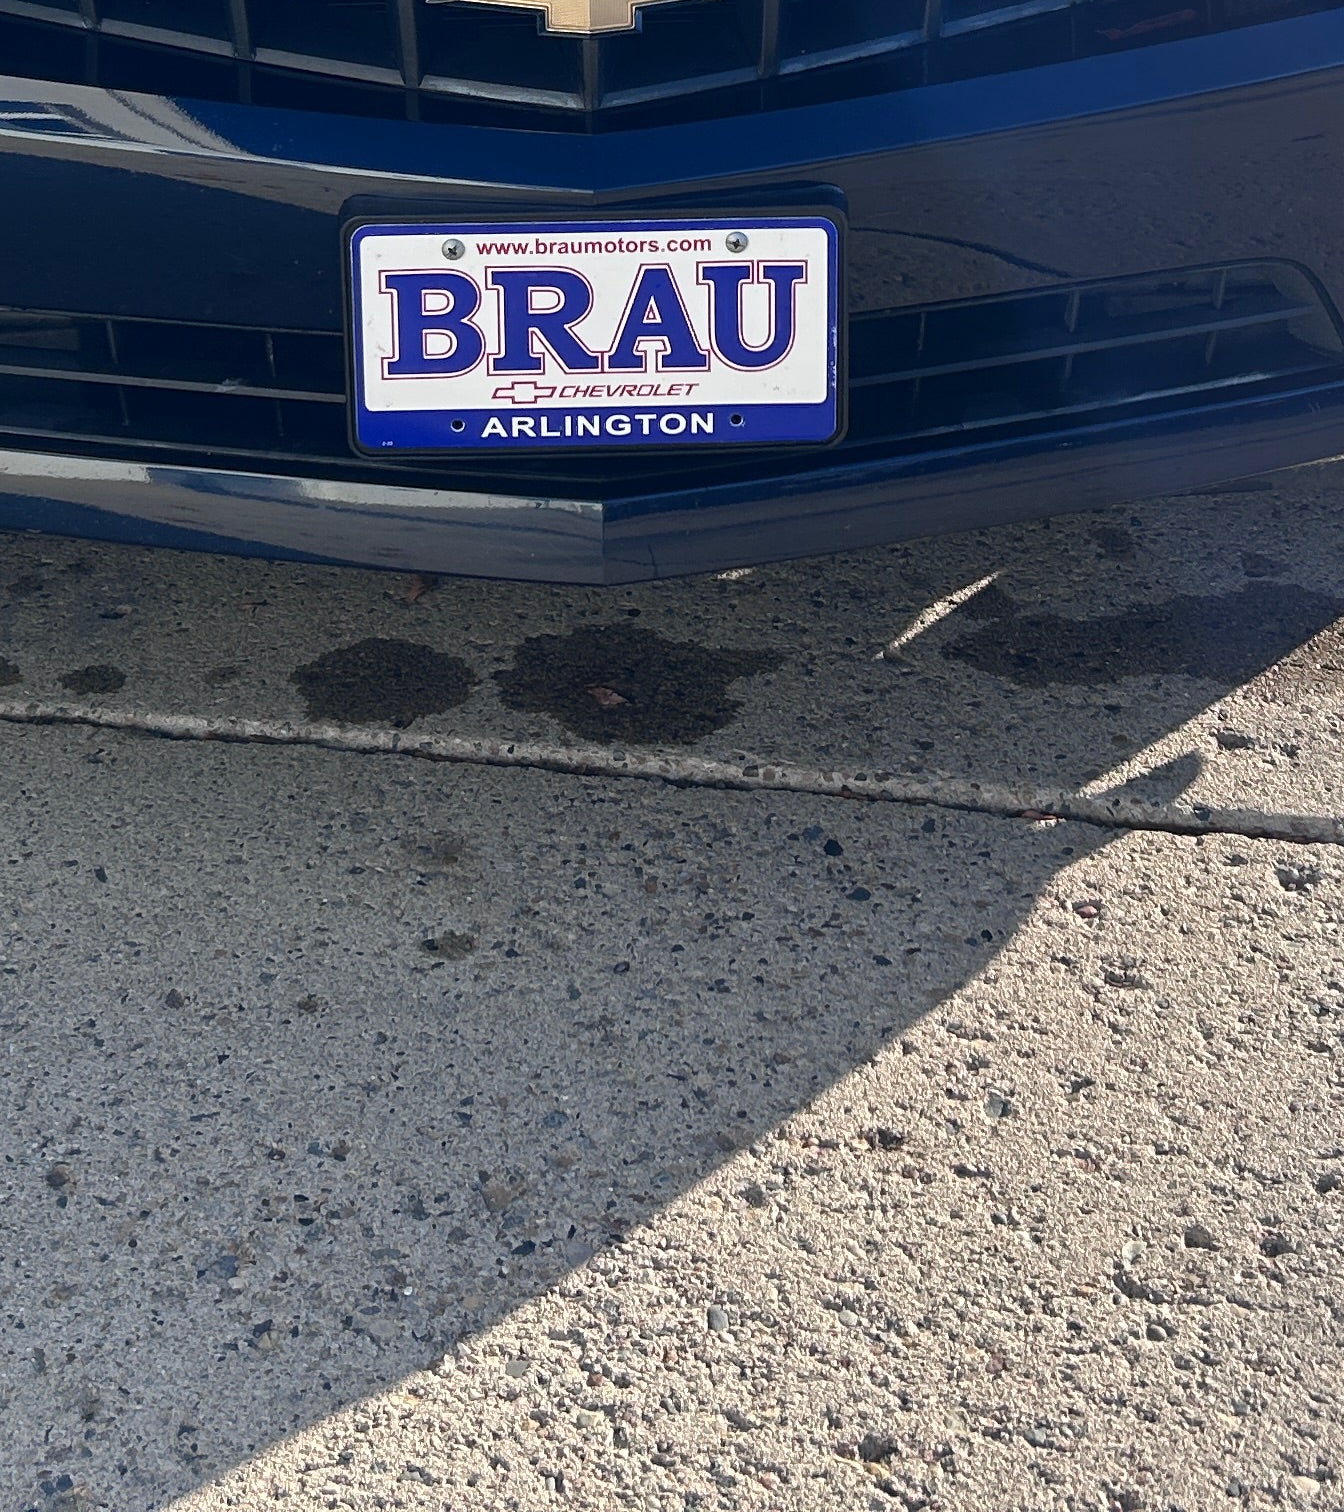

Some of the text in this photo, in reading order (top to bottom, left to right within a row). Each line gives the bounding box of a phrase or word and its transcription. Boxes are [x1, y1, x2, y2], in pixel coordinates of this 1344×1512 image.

[475, 235, 712, 256] www.braumotors.com
[378, 259, 808, 380] BRAU
[558, 382, 700, 399] CHEVROLET
[481, 412, 715, 438] ARLINGTON
